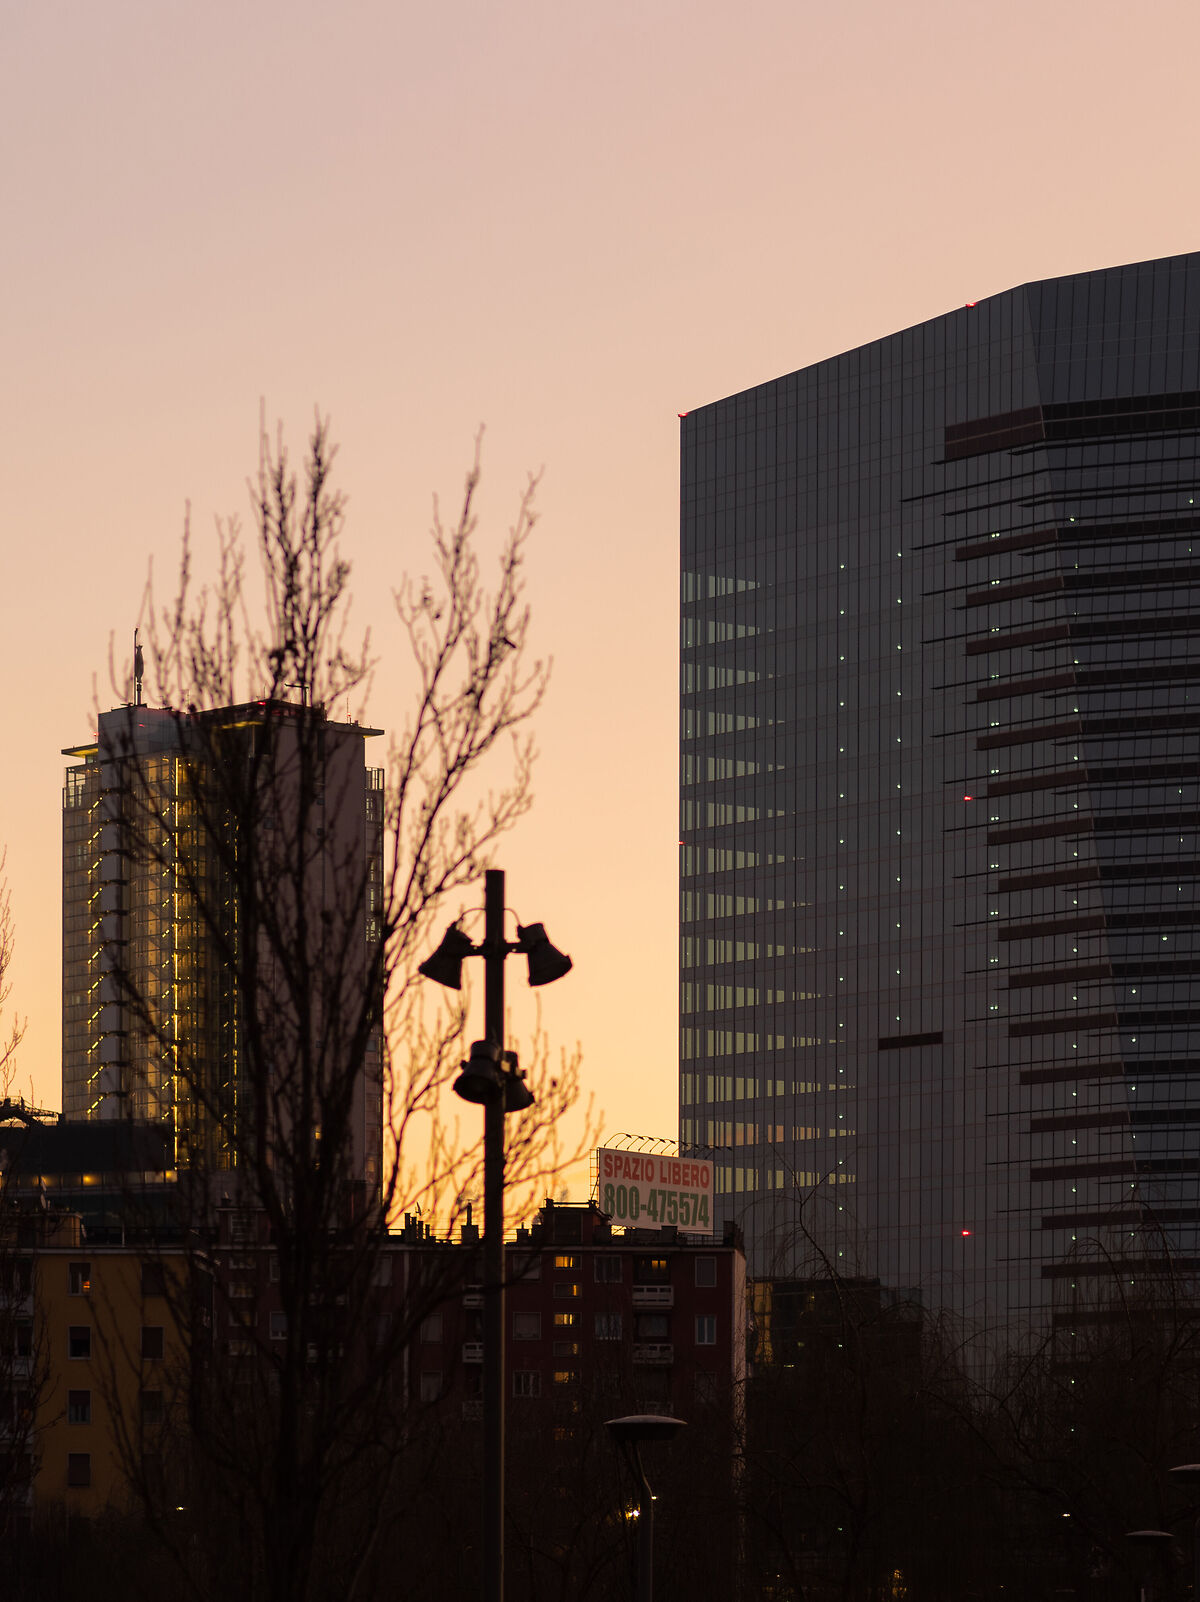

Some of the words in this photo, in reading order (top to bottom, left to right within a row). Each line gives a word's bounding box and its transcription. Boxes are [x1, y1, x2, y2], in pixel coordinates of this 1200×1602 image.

[603, 1153, 655, 1182] SPAZIO
[659, 1160, 710, 1189] LIBERO
[604, 1183, 710, 1228] 800-475574
